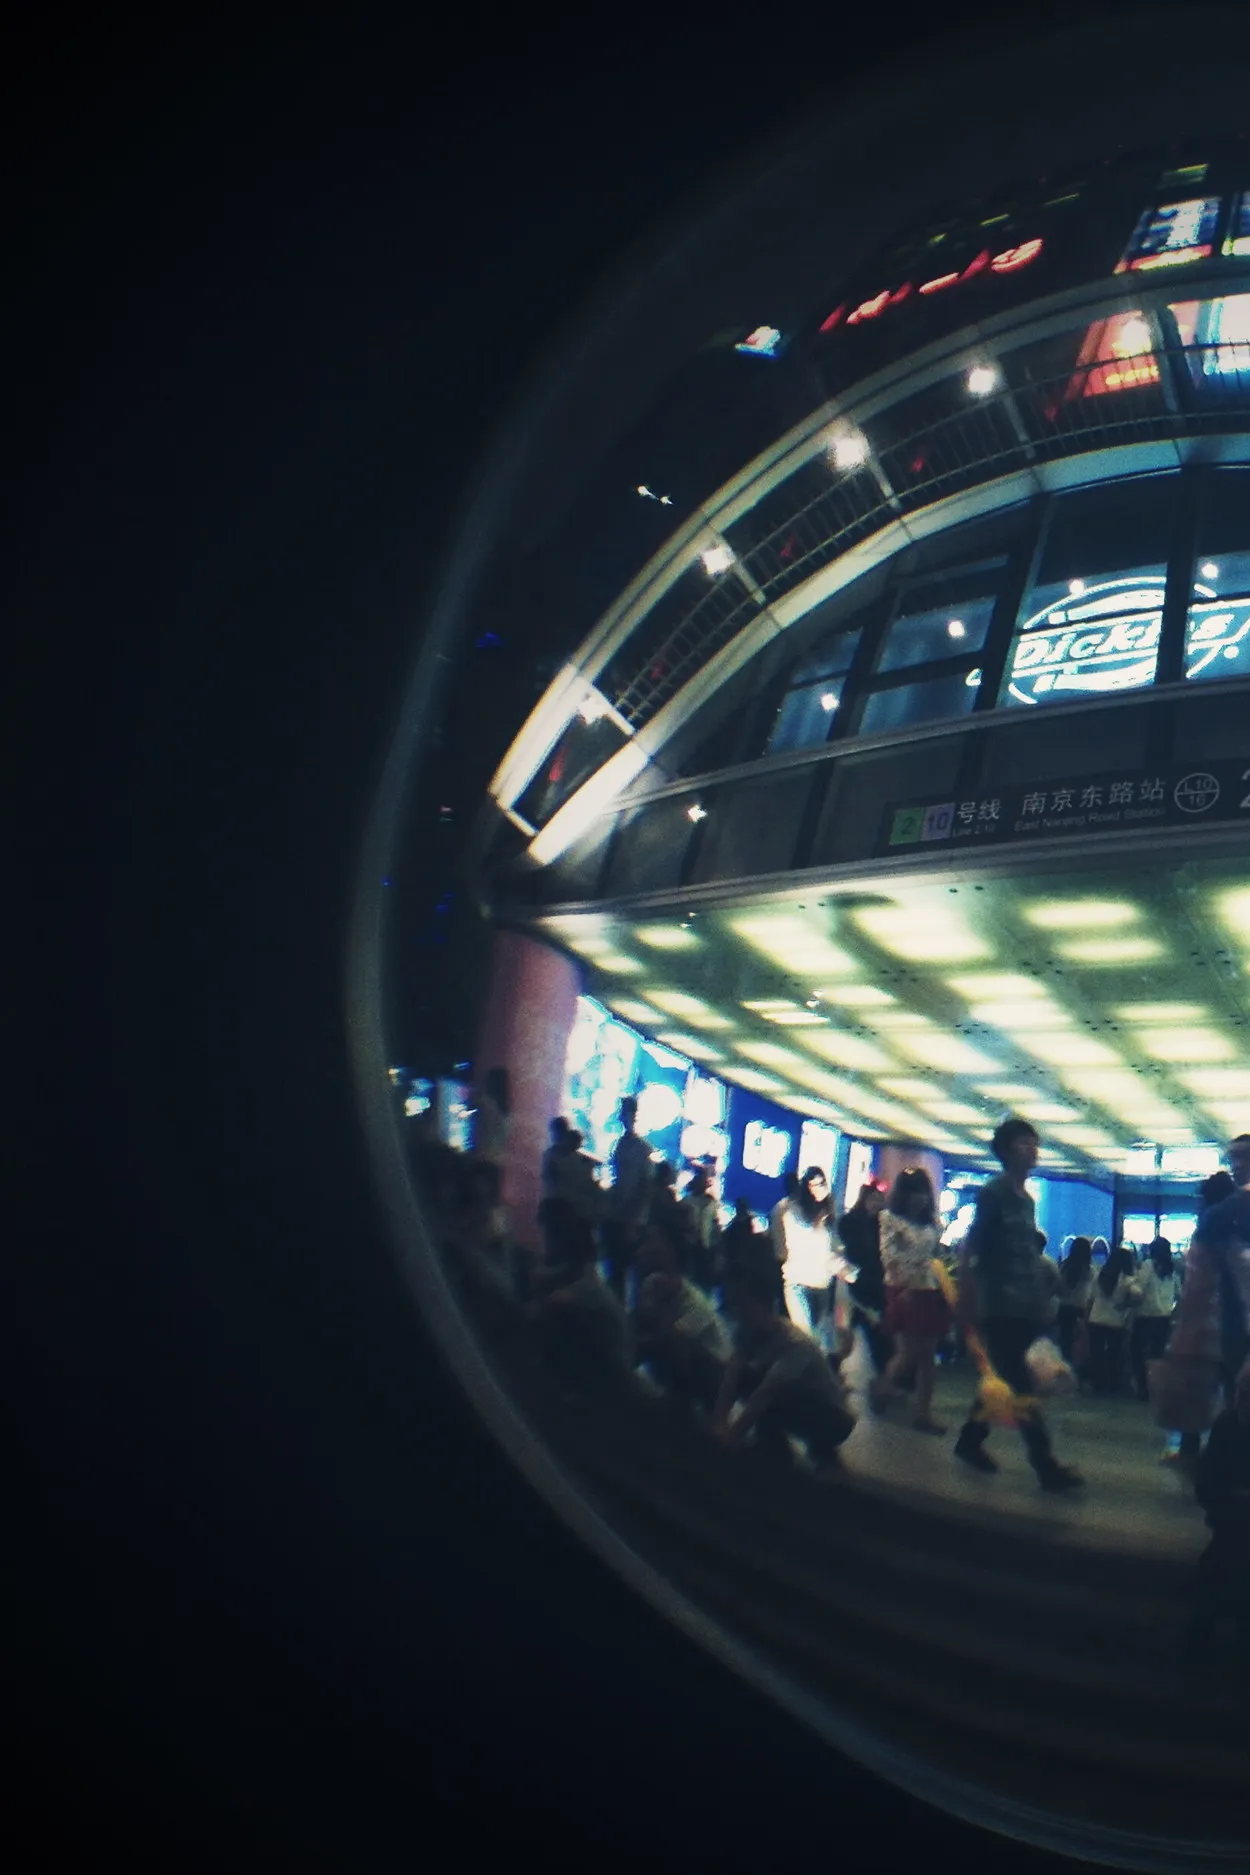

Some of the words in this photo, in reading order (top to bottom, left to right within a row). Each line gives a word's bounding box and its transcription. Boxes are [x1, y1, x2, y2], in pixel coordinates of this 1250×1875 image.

[1022, 777, 1167, 816] 南京东路站
[901, 817, 917, 836] 2
[928, 812, 948, 832] 10
[957, 799, 1001, 824] 号线
[1014, 820, 1039, 832] East
[1089, 811, 1120, 822] Road
